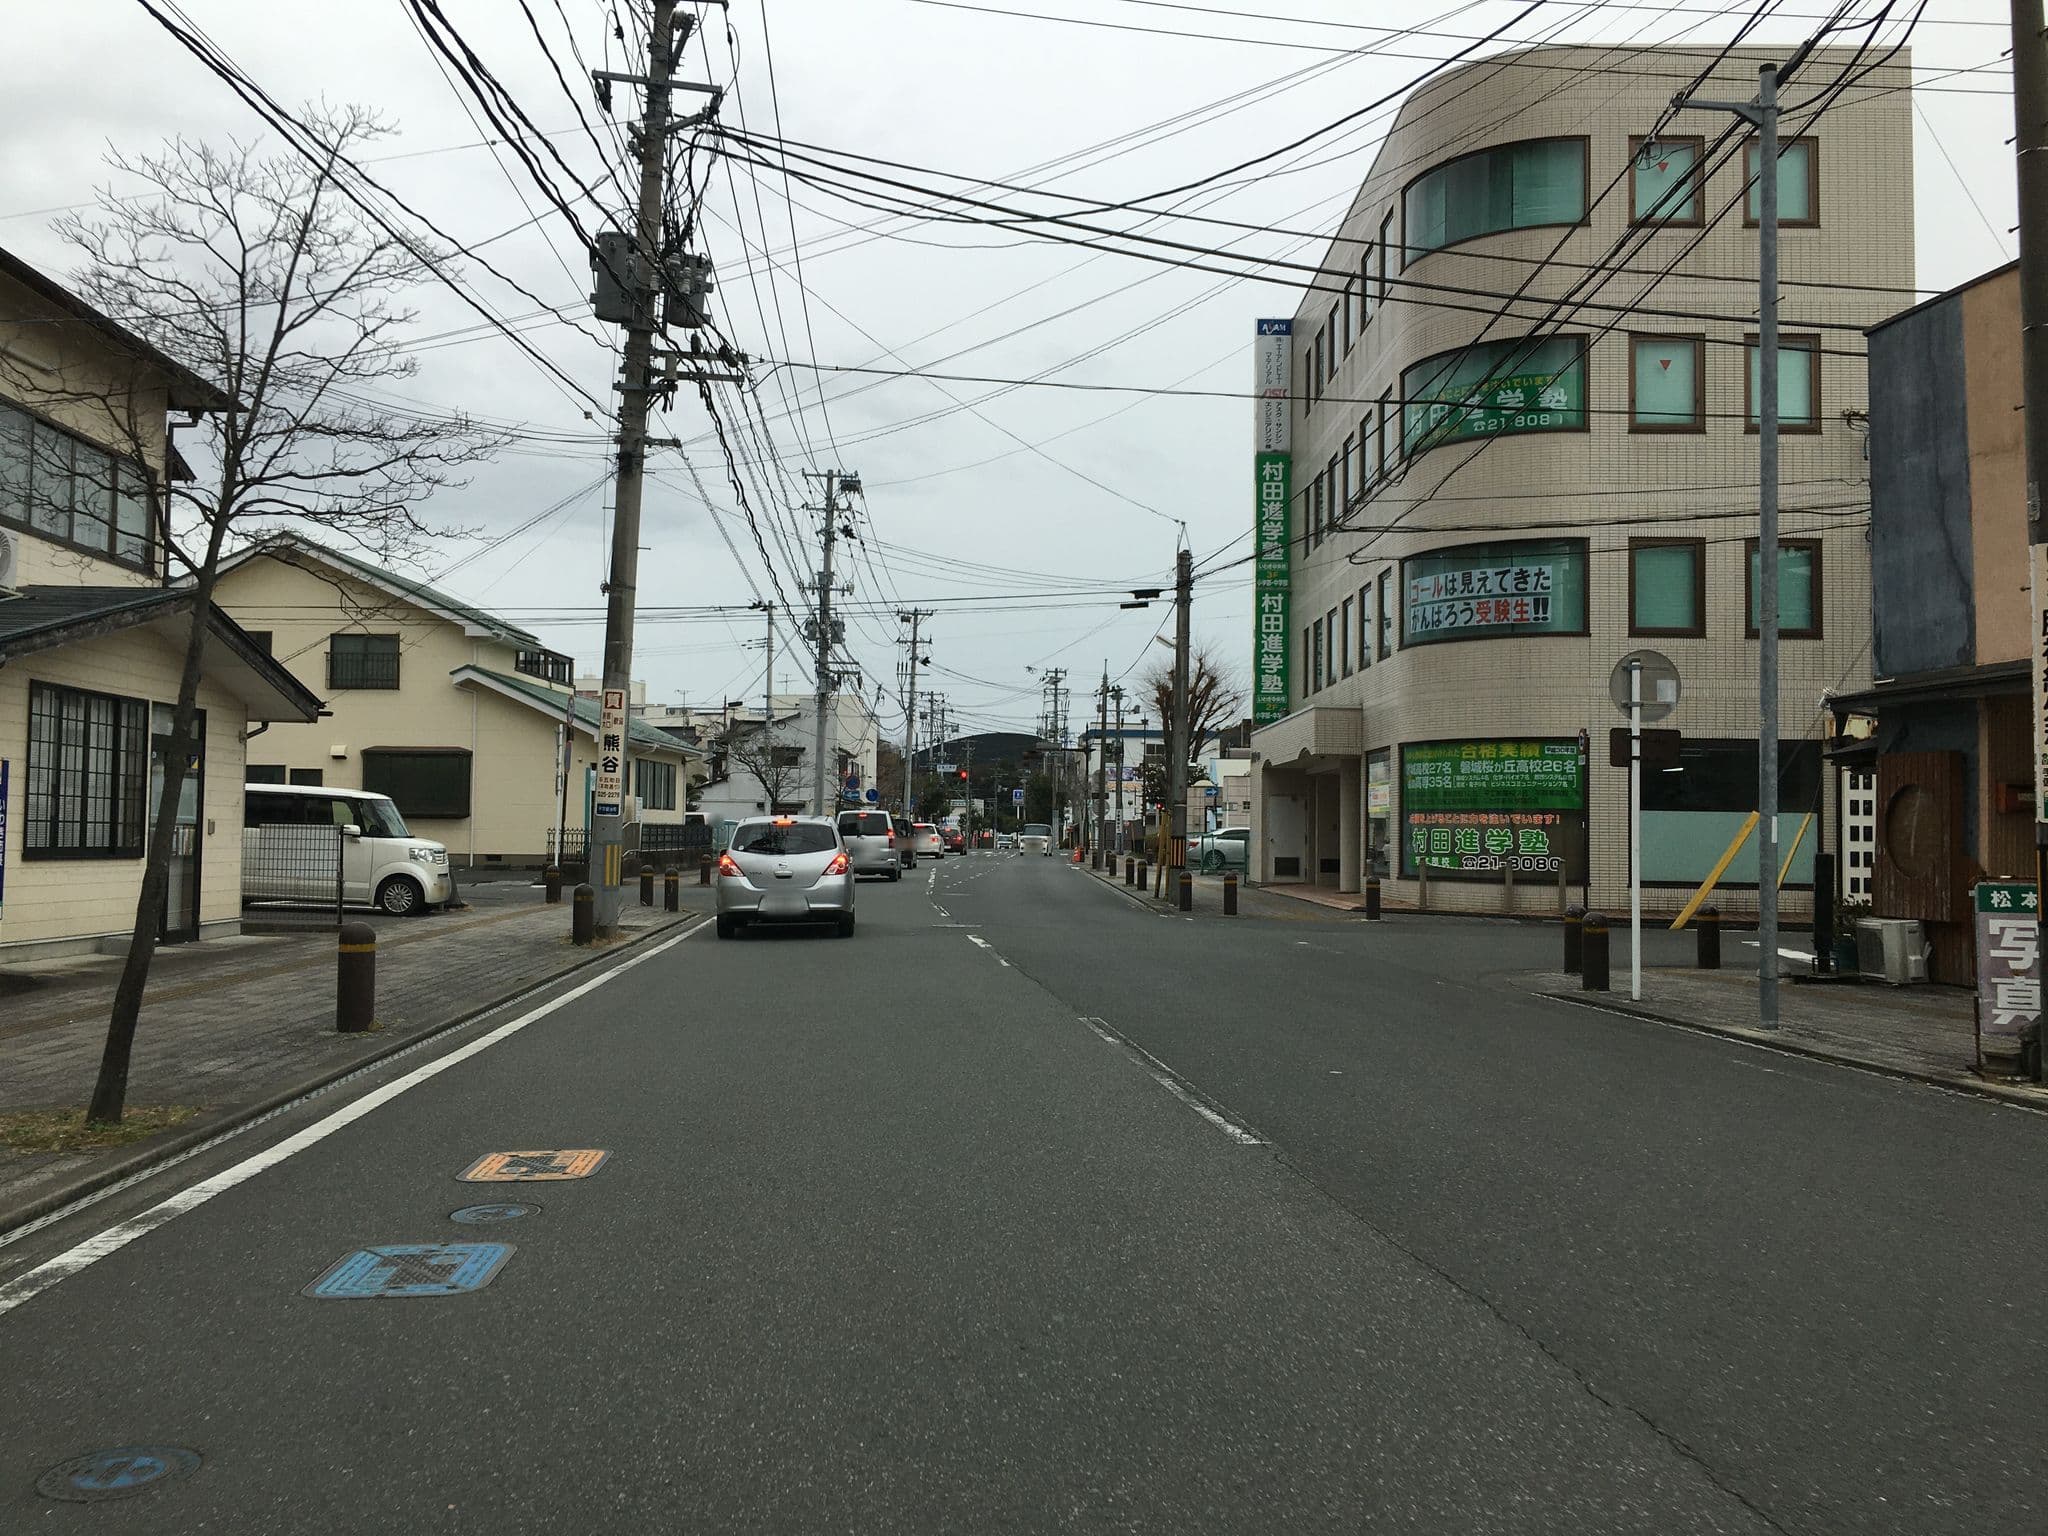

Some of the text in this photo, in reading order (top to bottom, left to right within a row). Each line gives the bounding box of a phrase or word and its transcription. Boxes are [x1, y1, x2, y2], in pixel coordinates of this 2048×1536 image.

[1262, 462, 1284, 561] 村田進学塾
[1411, 567, 1551, 603] ゴールは見えてきた
[1411, 597, 1549, 631] がんばろう受験生!!
[1261, 593, 1283, 693] 村田進学塾
[602, 734, 620, 773] 熊谷
[1412, 828, 1549, 854] 村田進学塾
[1989, 919, 2041, 1025] 写真
